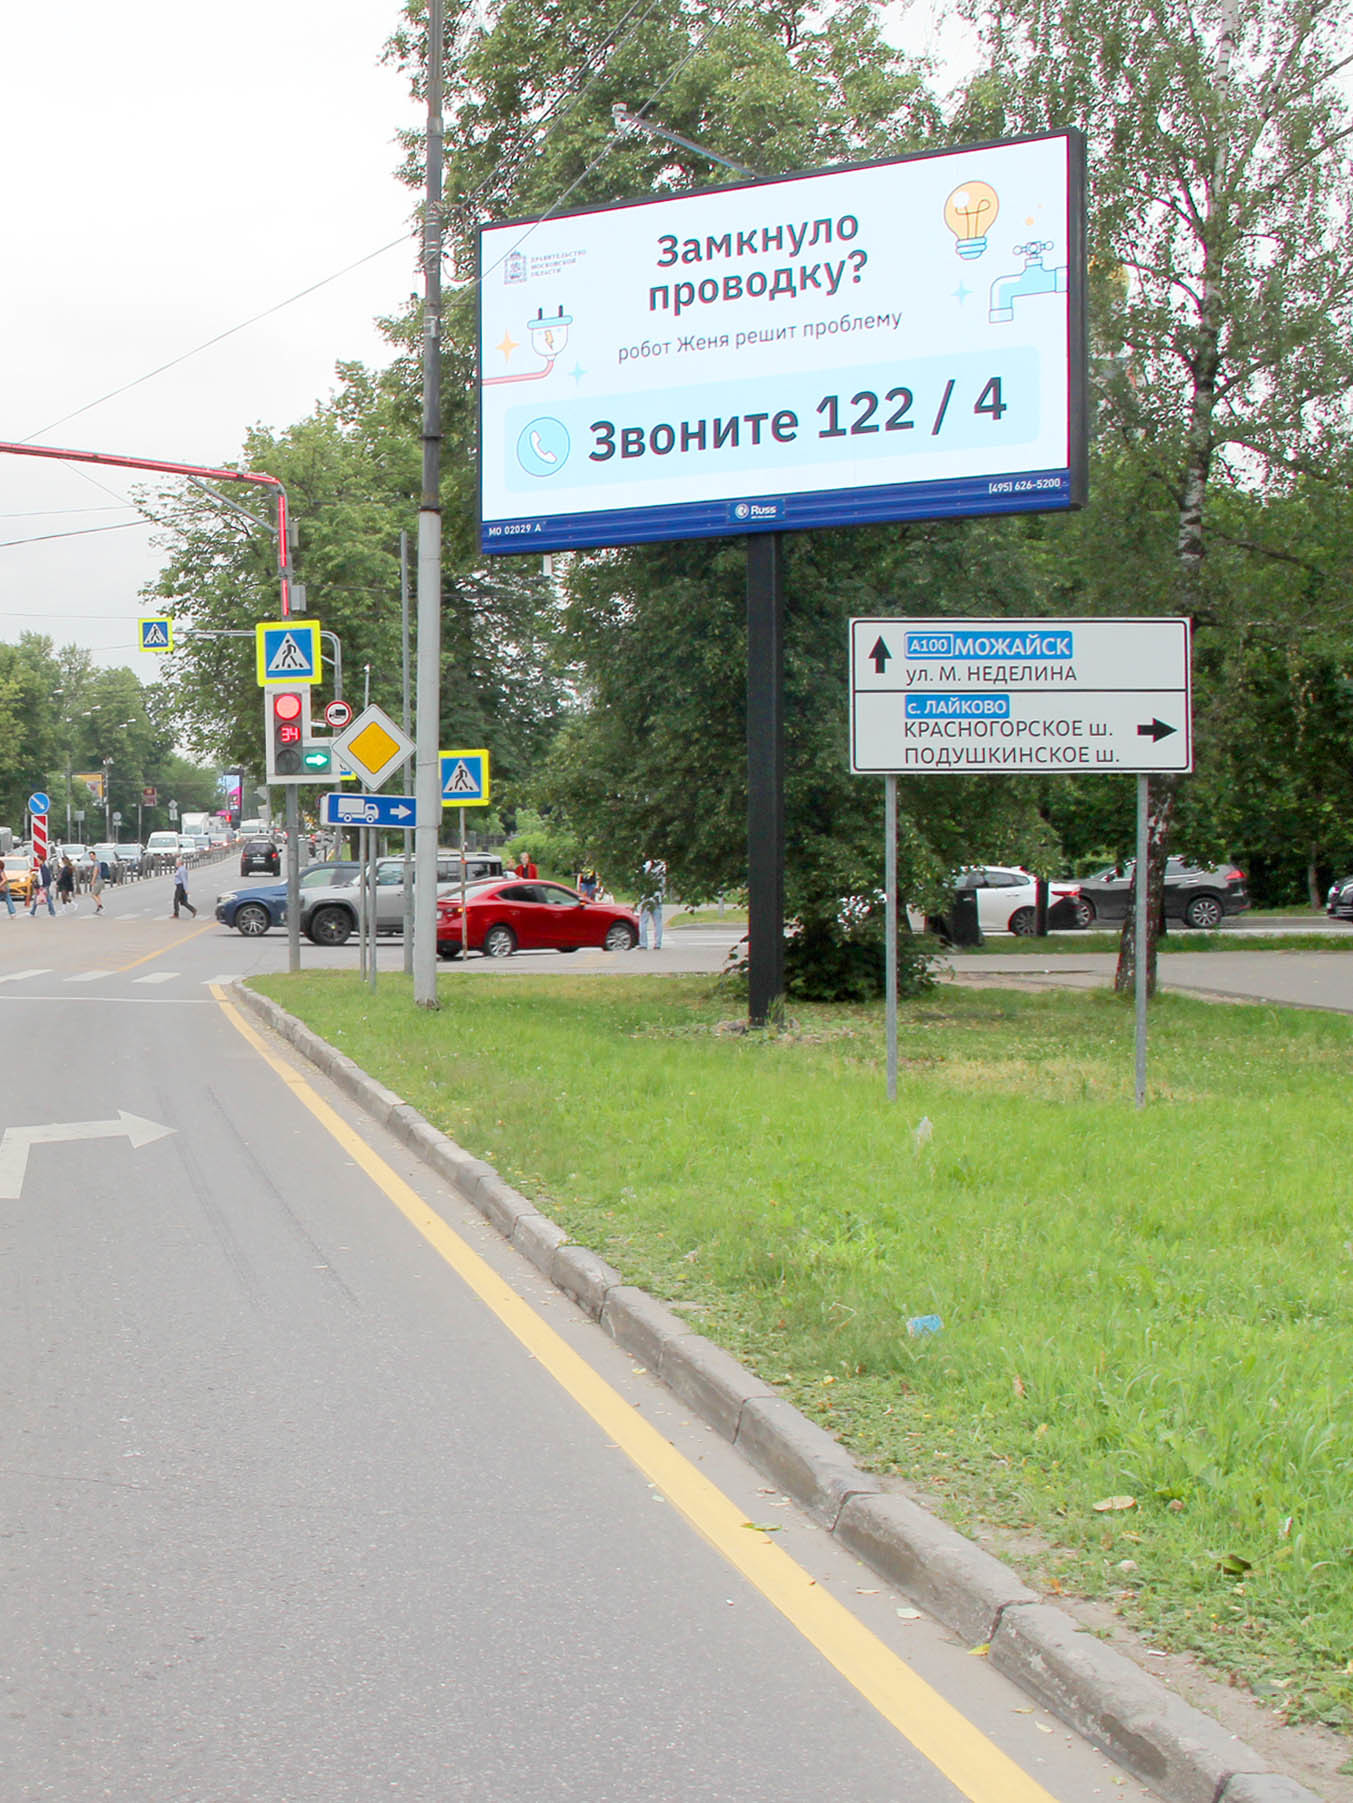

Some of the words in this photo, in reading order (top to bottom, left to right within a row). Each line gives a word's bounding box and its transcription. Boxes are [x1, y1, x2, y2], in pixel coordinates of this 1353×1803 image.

[656, 214, 859, 268] Замкнуло
[649, 249, 869, 317] проводку?
[617, 340, 673, 365] робот
[676, 333, 730, 354] Женя
[735, 325, 798, 350] решит
[803, 311, 903, 340] проблему
[588, 408, 799, 463] Звоните
[815, 385, 915, 439] 122
[930, 378, 956, 436] /
[973, 376, 1008, 421] 4
[1014, 478, 1061, 492] 626-5200
[954, 633, 1071, 657] МОЖАЙСК
[905, 668, 934, 687] ул.
[938, 666, 961, 682] М.
[966, 665, 1078, 685] НЕДЕЛИНА
[907, 702, 921, 715] с.
[924, 697, 1007, 716] ЛАЙКОВО
[280, 727, 301, 743] 34
[904, 719, 1083, 738] КРАСНОГОРСКОЕ
[1089, 722, 1114, 738] ш.
[904, 746, 1090, 767] ПОДУШКИНСКОЕ
[1095, 749, 1121, 764] ш.
